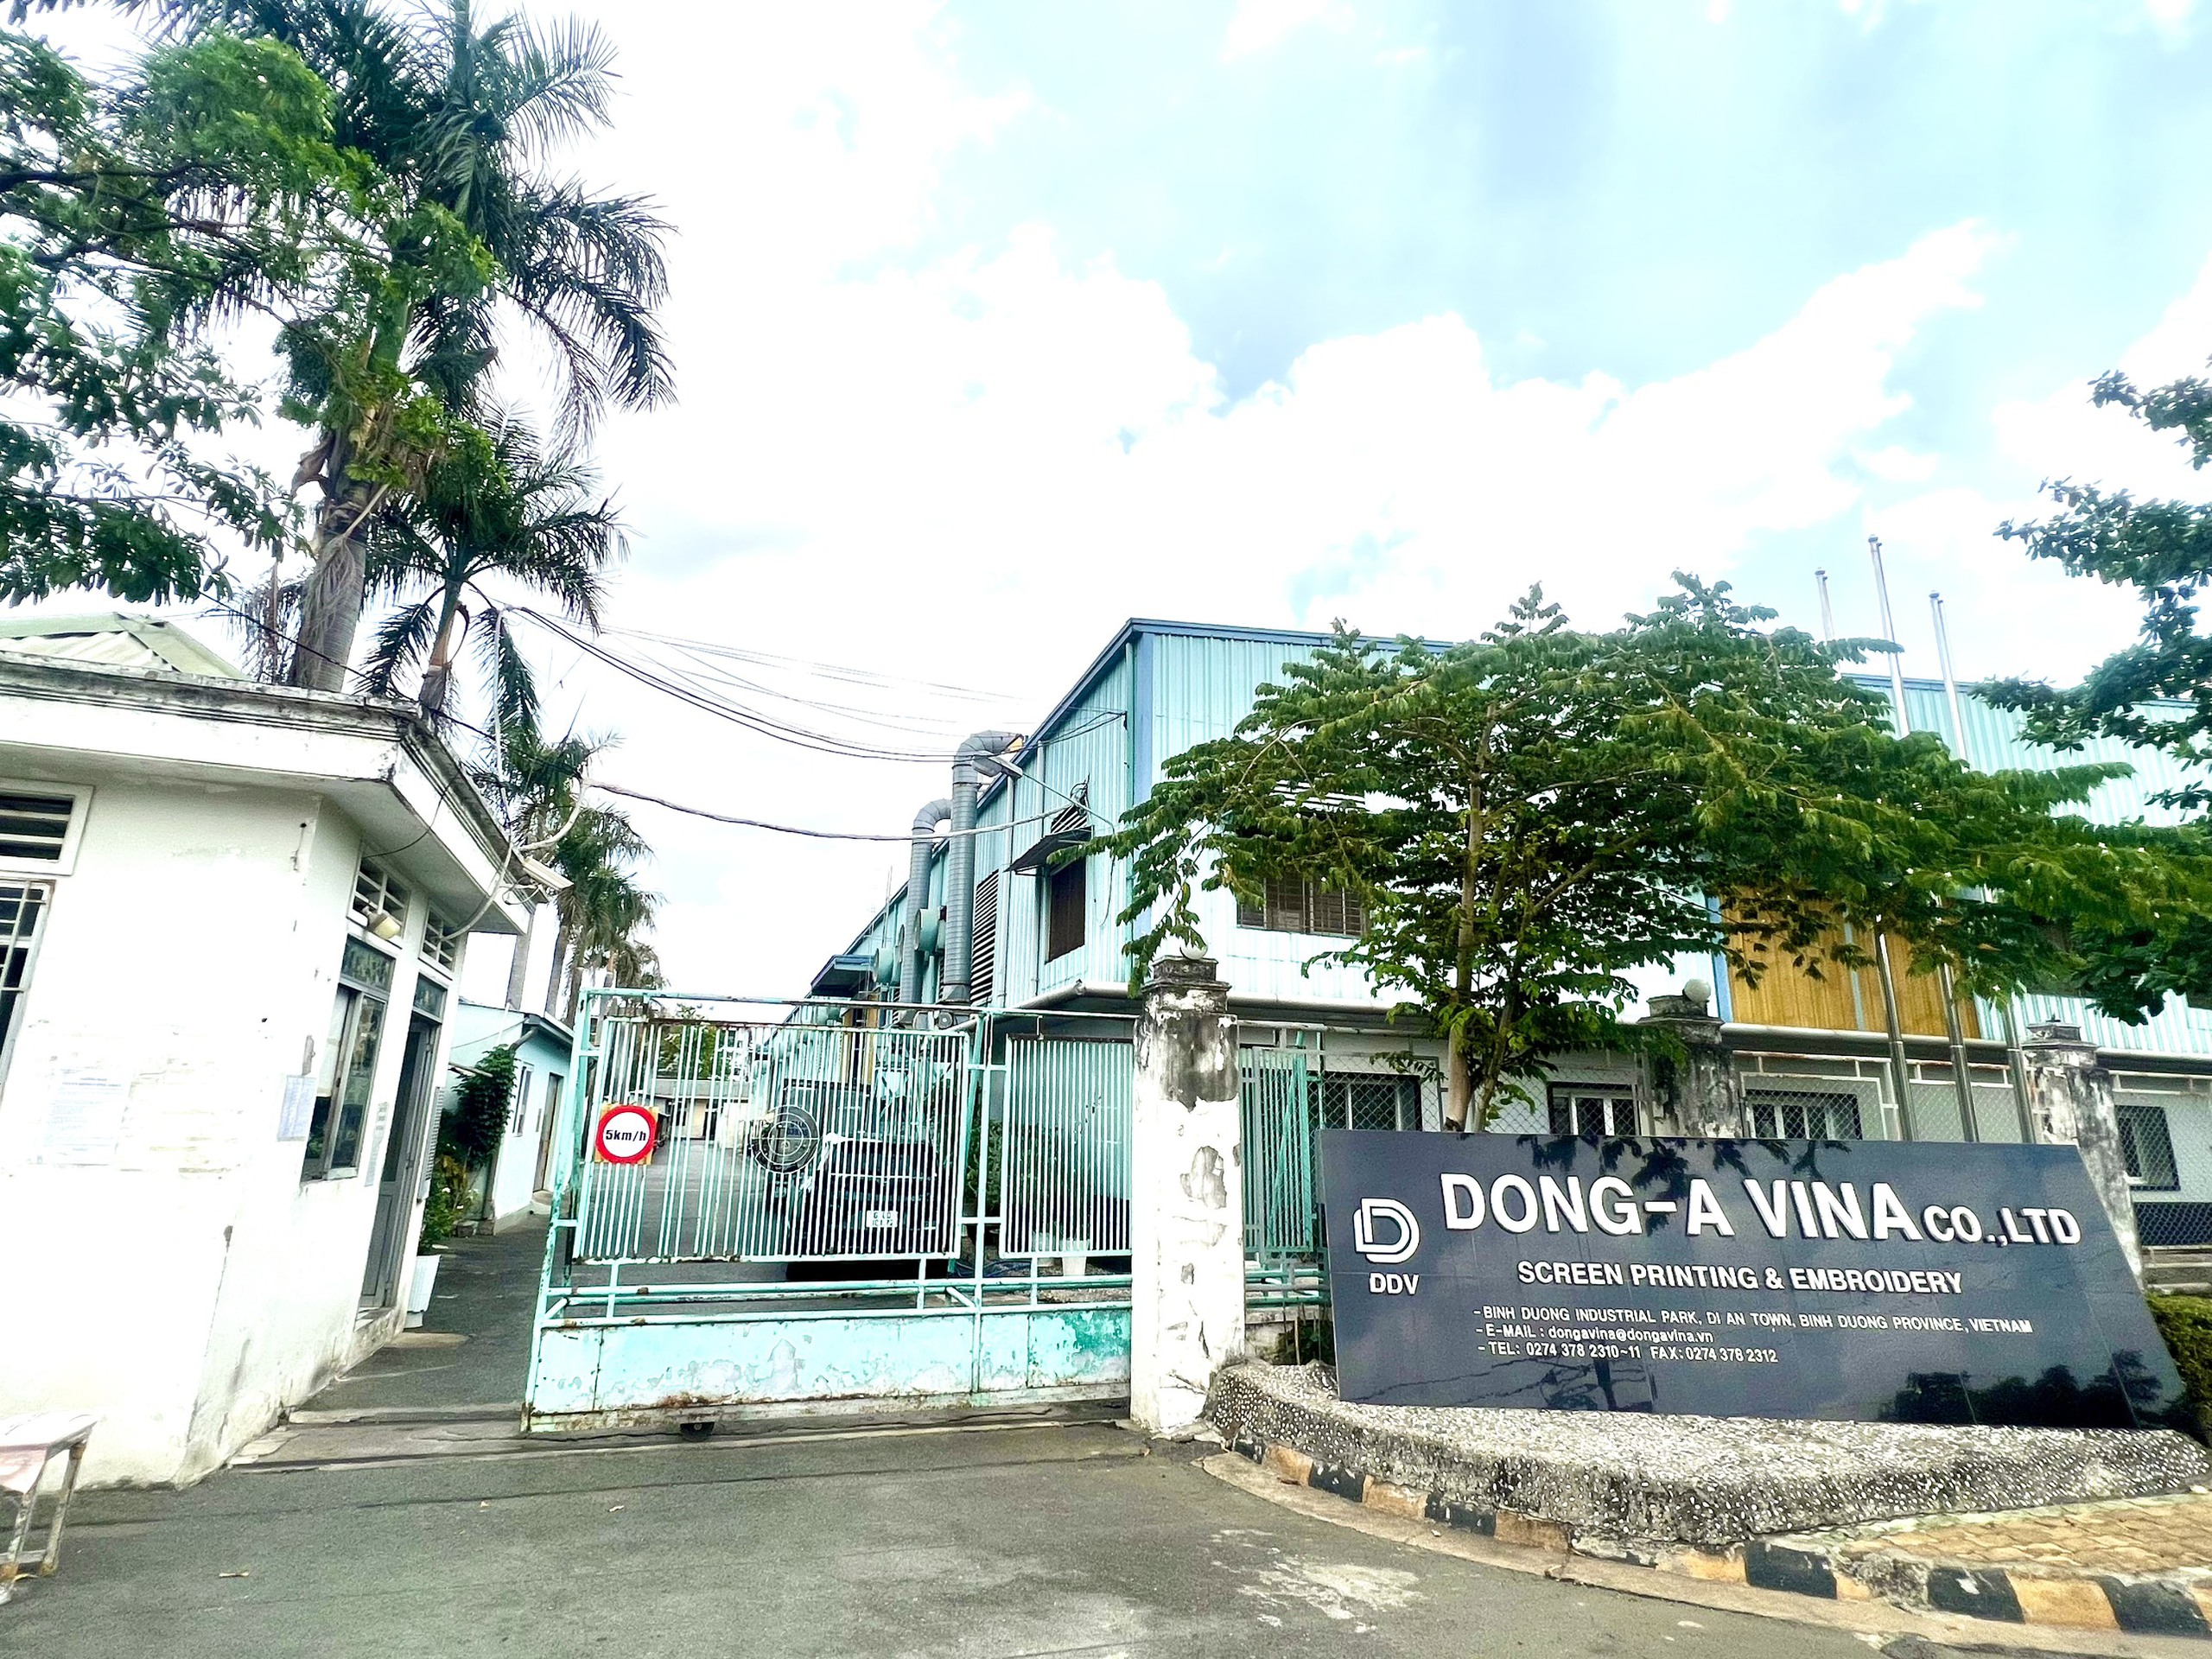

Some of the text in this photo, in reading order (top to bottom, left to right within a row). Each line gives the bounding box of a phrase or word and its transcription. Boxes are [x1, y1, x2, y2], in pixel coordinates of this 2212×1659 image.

[605, 1129, 646, 1141] 5km/h
[1440, 1173, 1735, 1236] DONG-A
[1743, 1179, 1923, 1241] VINA
[1369, 1272, 1420, 1294] DDV
[1517, 1261, 1962, 1294] SCREEN PRINTING & EMBROIDERY
[1521, 1306, 1570, 1321] DUONG
[1575, 1308, 1656, 1323] INDUSTRIAL
[1661, 1310, 1702, 1325] PARK,
[1706, 1311, 1721, 1325] DI
[1726, 1312, 1746, 1325] AN
[1798, 1313, 1834, 1328] BINH
[1837, 1314, 1889, 1330] DUONG
[1891, 1316, 1969, 1333] PROVINCE,
[1968, 1318, 2033, 1333] VIETNAM
[1548, 1325, 1713, 1345] dongavina@dongavina.vn
[1526, 1342, 1557, 1357] 0274
[1560, 1343, 1586, 1357] 378
[1719, 1347, 1745, 1362] 378
[1745, 1348, 1779, 1363] 2312
